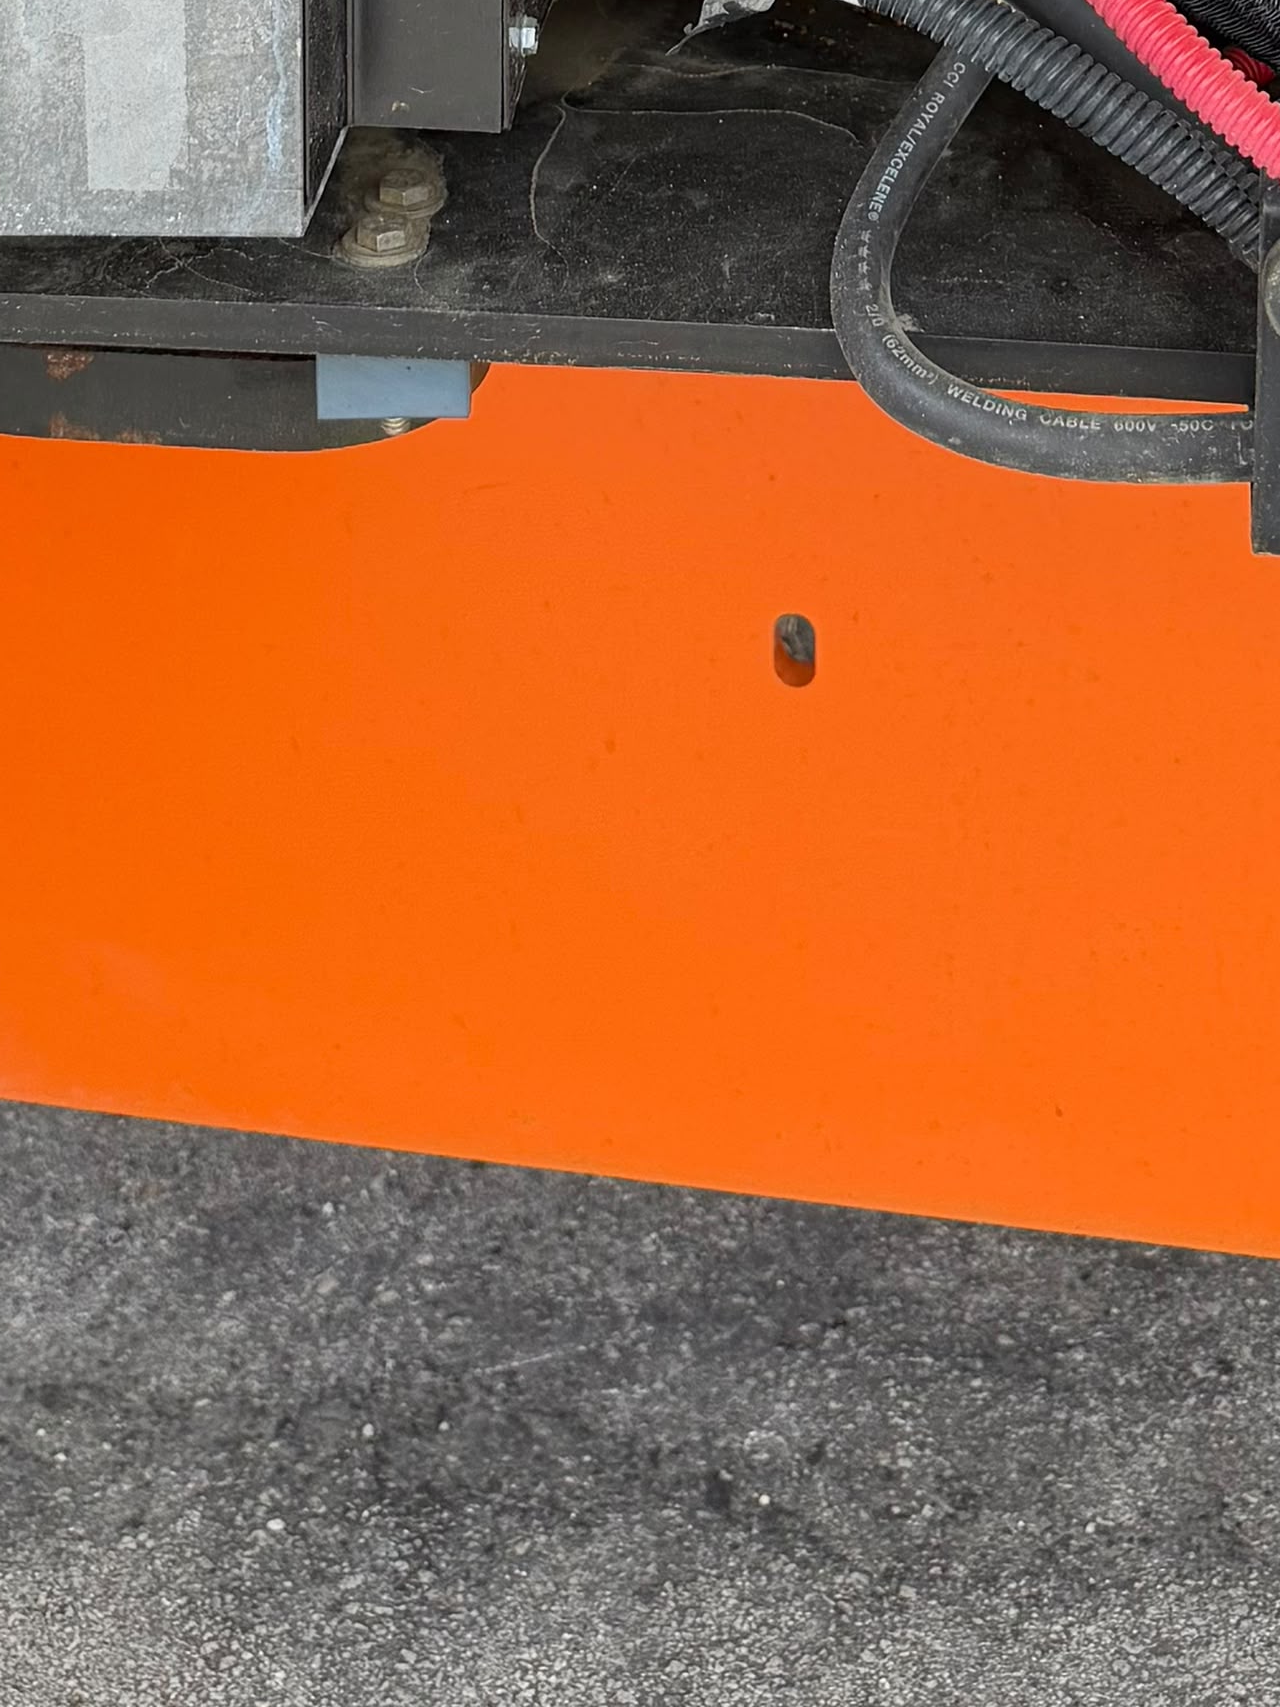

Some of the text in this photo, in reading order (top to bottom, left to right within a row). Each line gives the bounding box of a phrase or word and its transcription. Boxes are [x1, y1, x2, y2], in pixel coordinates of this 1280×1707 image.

[944, 62, 965, 89] CCI
[946, 384, 1028, 421] WELDING
[1039, 414, 1101, 431] CABLE
[1113, 419, 1157, 432] 600V
